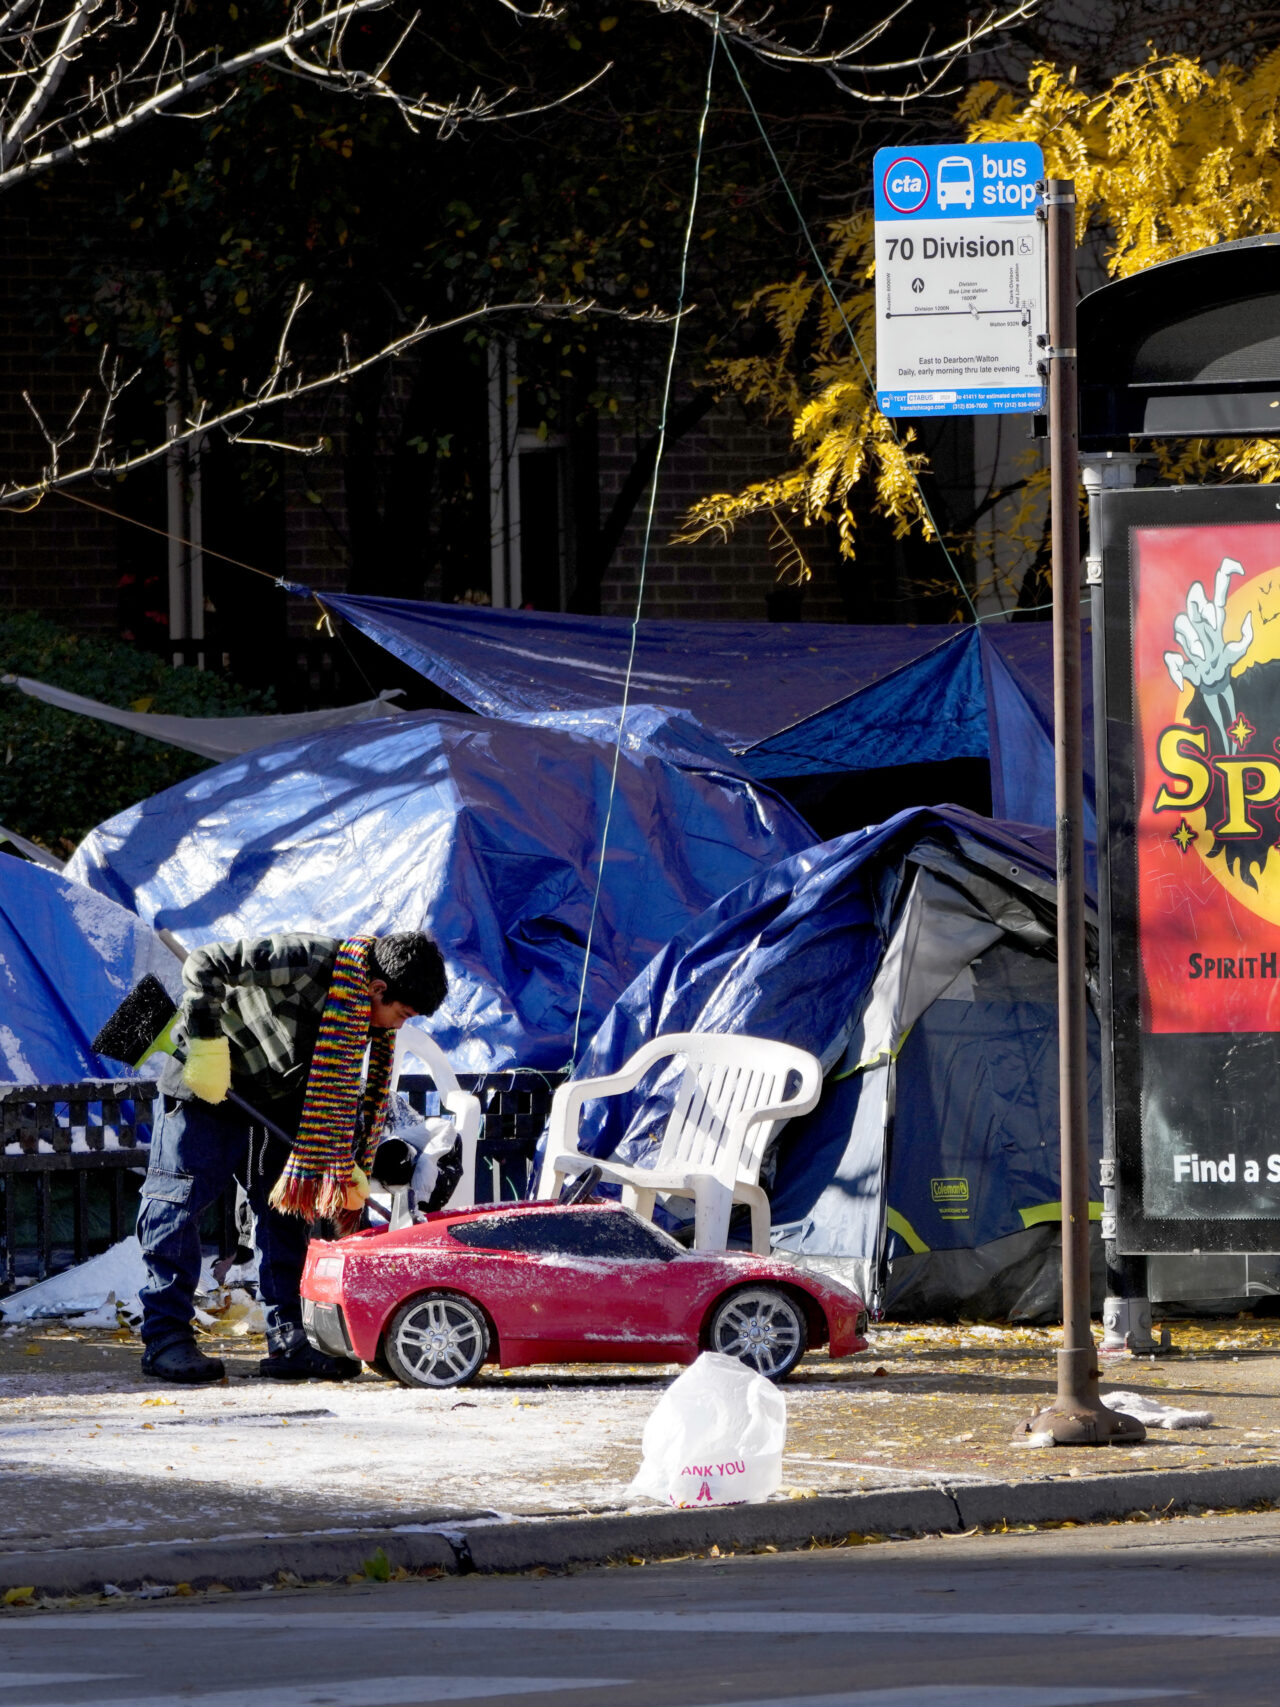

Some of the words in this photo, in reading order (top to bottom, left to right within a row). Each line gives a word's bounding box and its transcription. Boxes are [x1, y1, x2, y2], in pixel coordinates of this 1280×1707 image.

[983, 154, 1027, 179] bus
[891, 175, 922, 193] cta
[983, 180, 1036, 209] stop
[885, 237, 914, 260] 70
[923, 235, 1014, 259] Division
[919, 357, 934, 365] East
[898, 368, 916, 377] Daily,
[918, 368, 934, 376] early
[936, 367, 963, 376] morning
[980, 365, 992, 373] late
[993, 365, 1020, 374] evening
[1173, 1153, 1236, 1183] Find
[1243, 1161, 1260, 1182] a
[933, 1181, 962, 1196] Coleman
[681, 1464, 713, 1477] ANK
[716, 1460, 746, 1477] YOU
